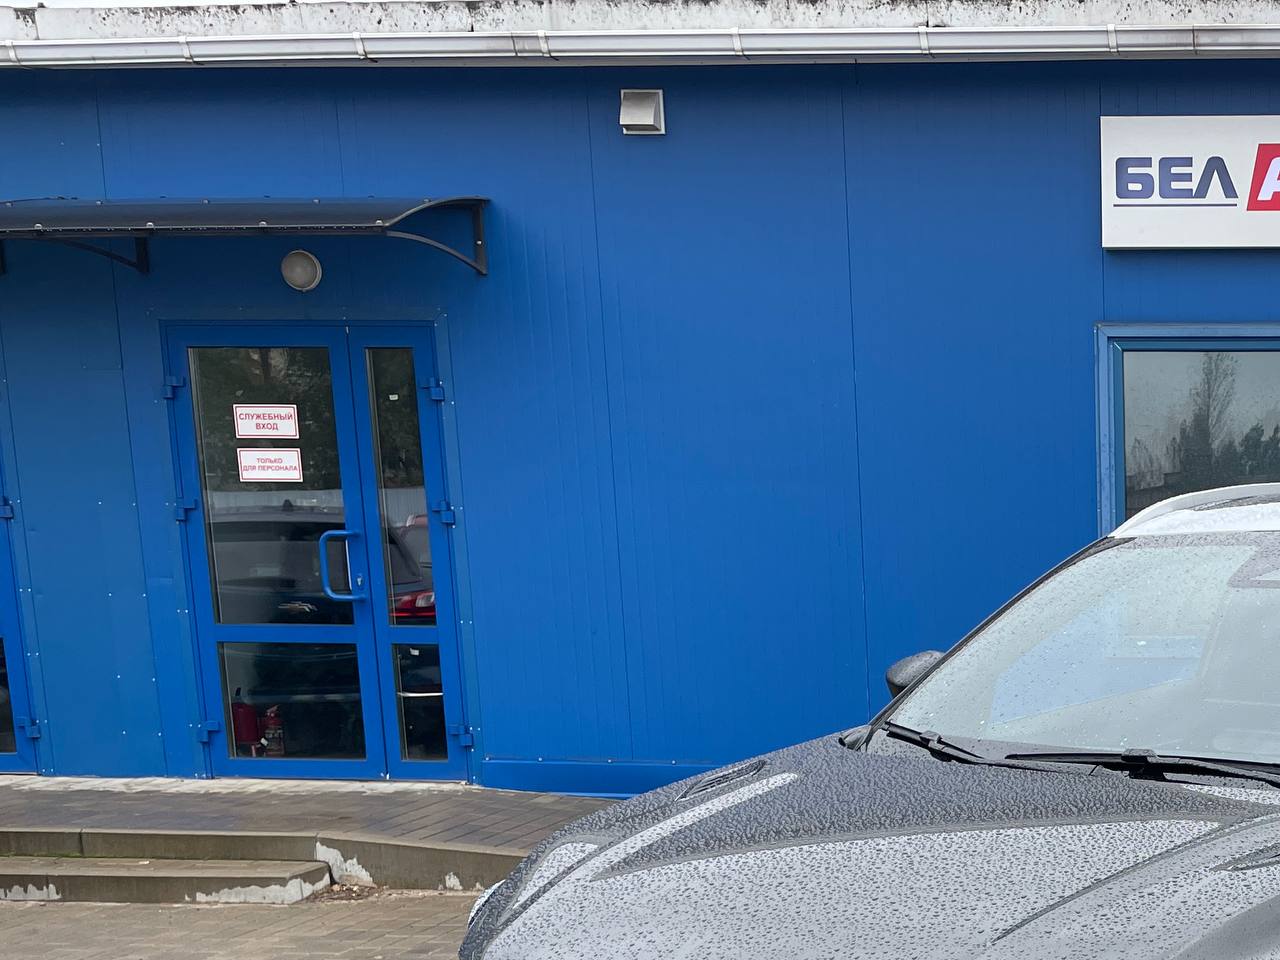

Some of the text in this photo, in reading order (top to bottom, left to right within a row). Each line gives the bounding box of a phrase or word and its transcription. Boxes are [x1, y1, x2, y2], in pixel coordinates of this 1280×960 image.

[1114, 156, 1238, 200] БЕЛ
[238, 412, 293, 421] СЛУЖЕБНЫЙ
[255, 422, 279, 431] ВХОД
